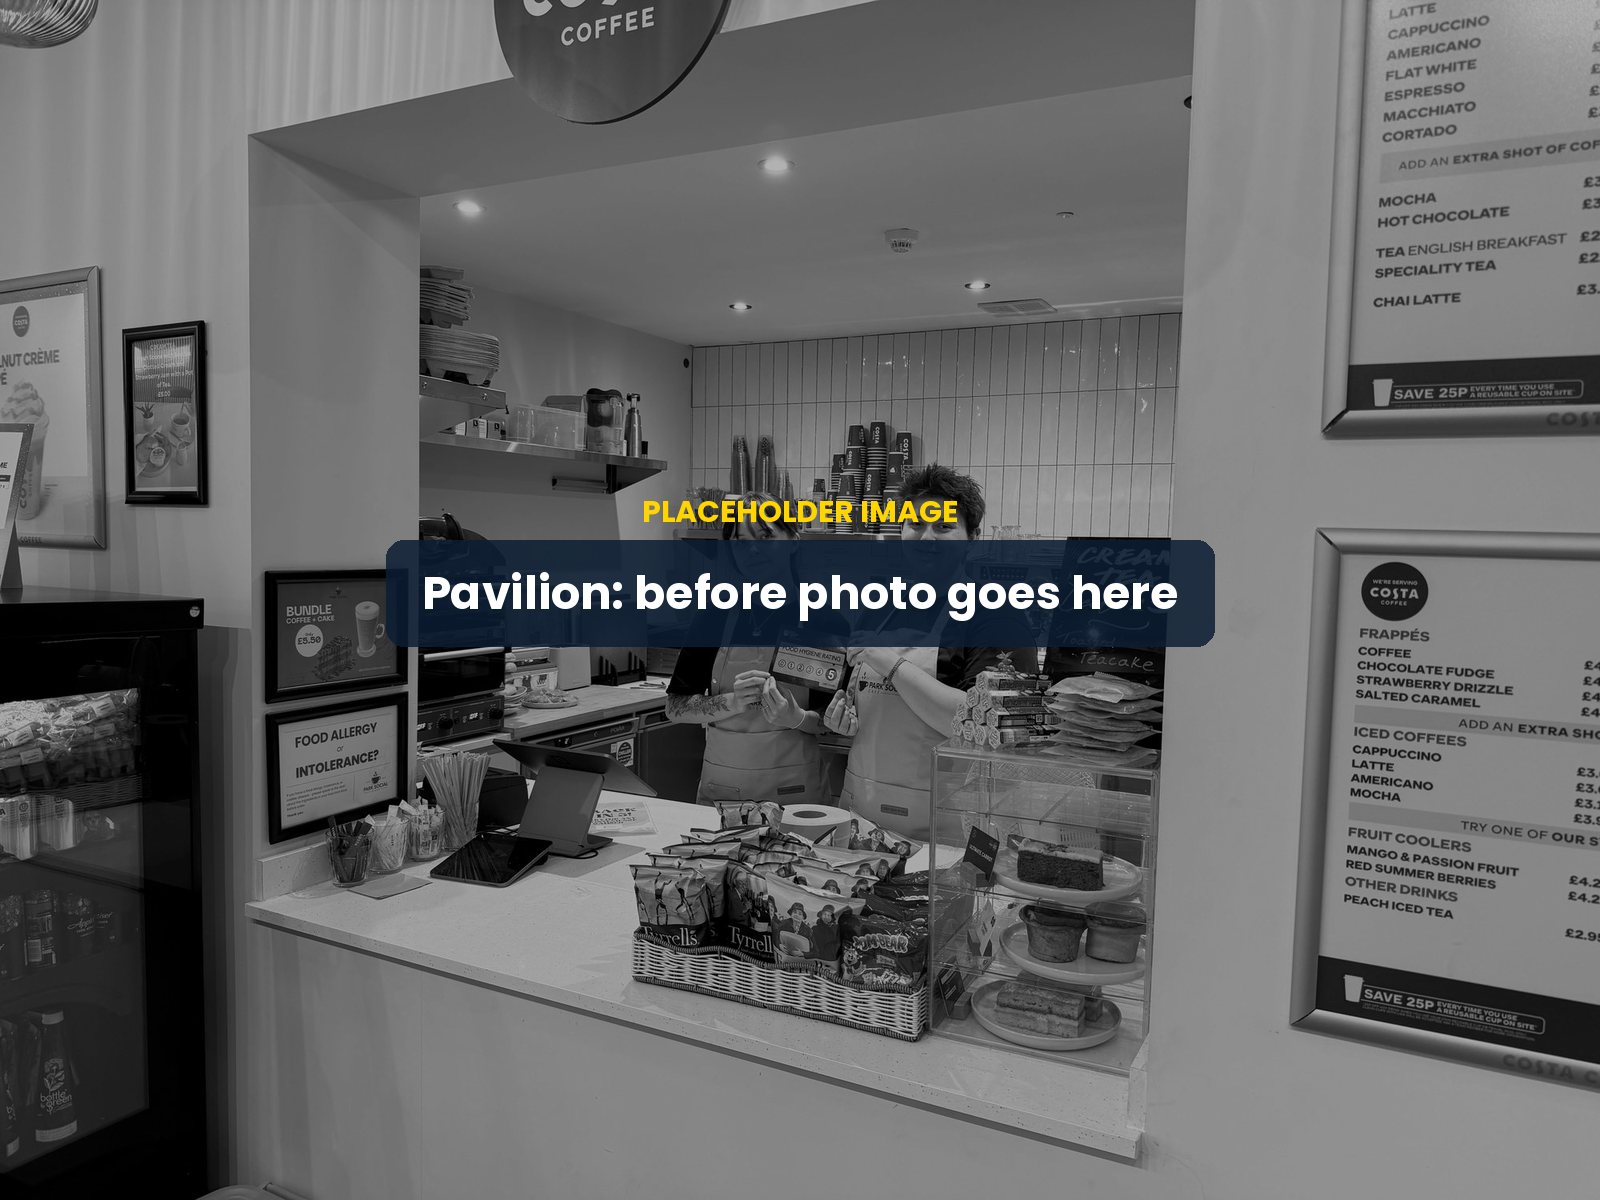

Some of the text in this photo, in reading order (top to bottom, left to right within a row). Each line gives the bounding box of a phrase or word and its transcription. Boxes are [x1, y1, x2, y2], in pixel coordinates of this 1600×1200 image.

[1389, 2, 1437, 20] LATTE
[560, 7, 655, 46] COFFEE
[1387, 15, 1490, 40] CAPPUCCINO
[1386, 37, 1481, 61] AMERICANO
[1385, 59, 1477, 82] FLAT WHITE
[1384, 82, 1465, 102] ESPRESSO
[1383, 101, 1476, 123] MACCHIATO
[1382, 124, 1457, 143] CORTADO
[1398, 159, 1427, 171] ADD
[1430, 156, 1449, 168] AN
[1453, 151, 1500, 165] EXTRA
[1502, 145, 1543, 160] SHOT
[1546, 143, 1566, 155] OF
[1378, 192, 1437, 208] MOCHA
[1377, 215, 1410, 228] HOT
[1412, 206, 1510, 225] CHOCOLATE
[1376, 247, 1405, 259] TEA
[1408, 241, 1473, 256] ENGLISH
[1477, 233, 1568, 251] BREAKFAST
[1374, 262, 1462, 278] SPECIALITY
[1466, 260, 1496, 272] TEA
[1373, 294, 1410, 308] CHAI
[1413, 292, 1462, 305] LATTE
[23, 347, 60, 367] CRÈME
[1394, 388, 1434, 400] SAVE
[1439, 387, 1468, 399] 25P
[1519, 383, 1536, 391] YOU
[1469, 391, 1476, 399] A
[1476, 390, 1520, 398] REUSABLE
[1521, 390, 1539, 398] CUP
[1539, 389, 1552, 397] ON
[1370, 587, 1419, 600] COSTA
[286, 604, 332, 617] BUNDLE
[286, 616, 311, 624] COFFEE
[297, 636, 321, 645] £5.50
[1359, 628, 1430, 642] FRAPPÉS
[799, 648, 820, 658] HYGIENE
[822, 651, 841, 662] RATING
[1080, 651, 1155, 672] Teacake
[1358, 647, 1411, 658] COFFEE
[1357, 661, 1443, 676] CHOCOLATE
[1446, 666, 1495, 679] FUDGE
[1356, 675, 1451, 690] STRAWBERRY
[1454, 682, 1514, 695] DRIZZLE
[1355, 689, 1408, 702] SALTED
[1411, 694, 1481, 708] CARAMEL
[295, 722, 377, 748] FOOD ALLERGY
[1354, 726, 1467, 747] ICED COFFEES
[1458, 719, 1489, 730] ADD
[1492, 721, 1513, 733] AN
[1518, 724, 1568, 737] EXTRA
[1352, 744, 1442, 762] CAPPUCCINO
[296, 750, 379, 778] INTOLERANCE?
[1351, 759, 1600, 778] LATTE £3.
[1350, 773, 1434, 791] AMERICANO
[1350, 788, 1401, 802] MOCHA
[1348, 827, 1472, 852] FRUIT COOLERS
[1460, 820, 1585, 845] TRY ONE OF OUR
[1346, 845, 1520, 877] MANGO & PASSION FRUIT
[1346, 859, 1372, 871] RED
[1375, 863, 1435, 881] SUMMER
[1437, 872, 1497, 889] BERRIES
[1345, 876, 1600, 904] OTHER DRINKS £4.2
[1343, 894, 1389, 909] PEACH
[1391, 902, 1423, 914] ICED
[1426, 907, 1454, 919] TEA
[1364, 988, 1518, 1021] SAVE 25P EVERY TIME YOU USE
[1442, 1008, 1484, 1022] REUSABLE
[1485, 1016, 1502, 1025] CUP
[1502, 1018, 1516, 1027] ON
[1503, 1054, 1573, 1081] COSTA
[41, 1089, 67, 1103] bottle
[46, 1094, 72, 1115] green
